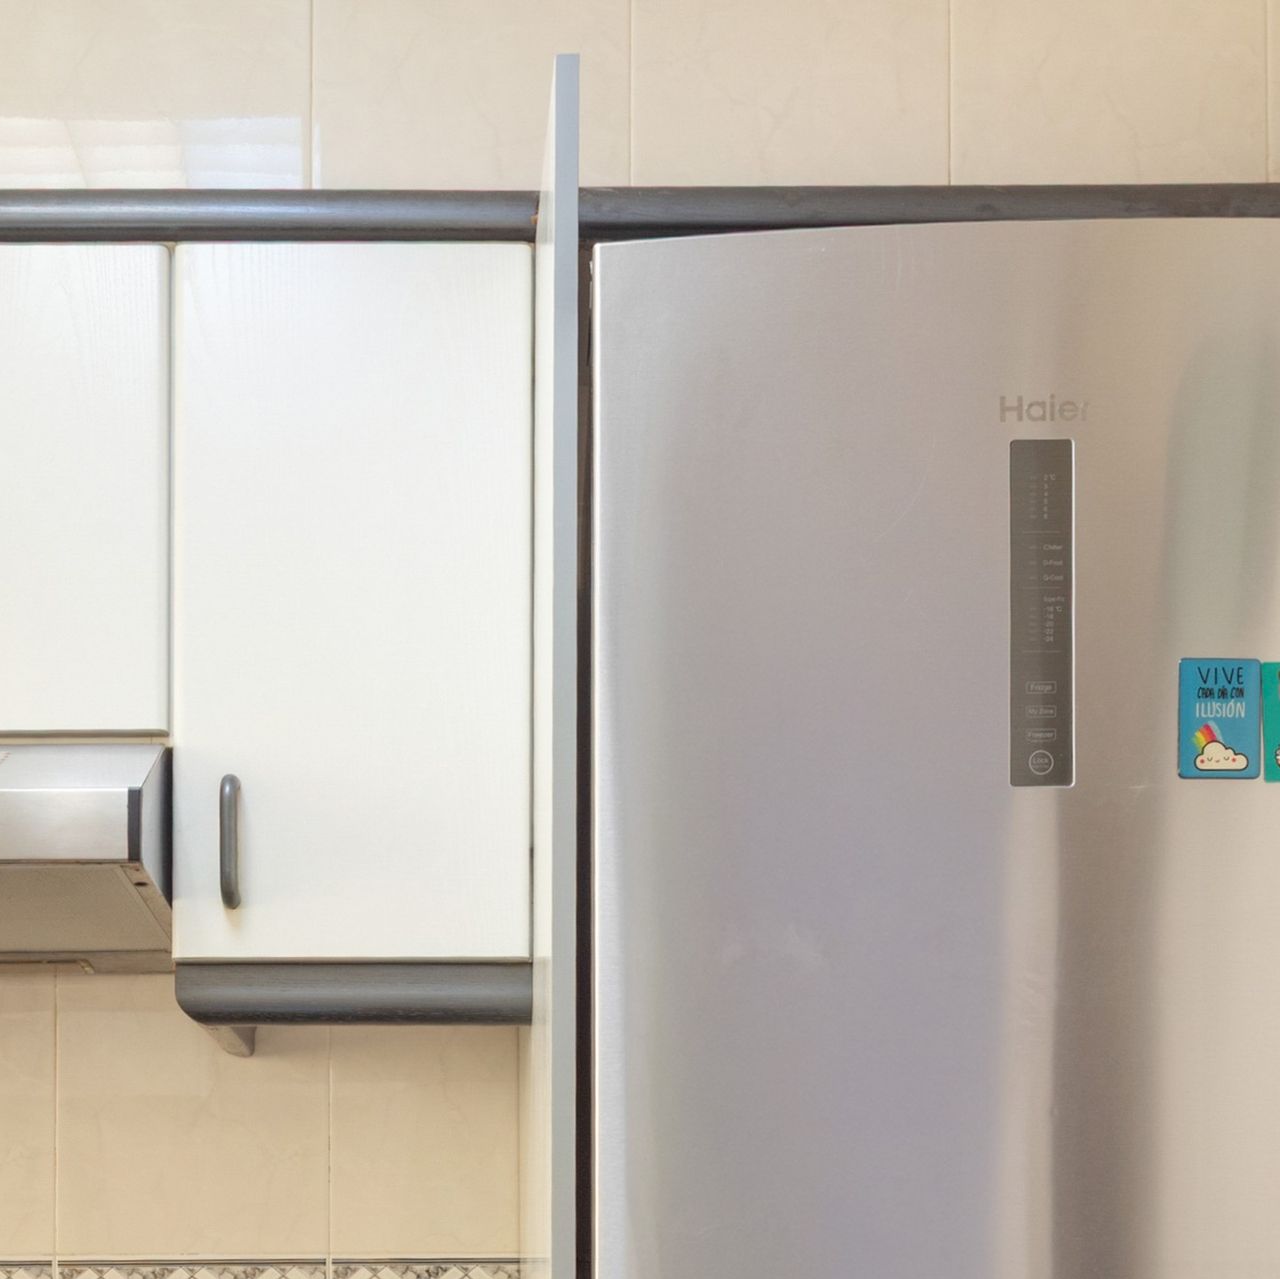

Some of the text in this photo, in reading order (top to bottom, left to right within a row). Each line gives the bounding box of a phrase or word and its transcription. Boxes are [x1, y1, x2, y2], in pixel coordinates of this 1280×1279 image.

[1000, 393, 1089, 422] Haier
[1197, 666, 1244, 685] VIVE
[1197, 687, 1215, 699] CADA
[1230, 687, 1244, 699] CON
[1196, 699, 1245, 718] ILUSIÓN
